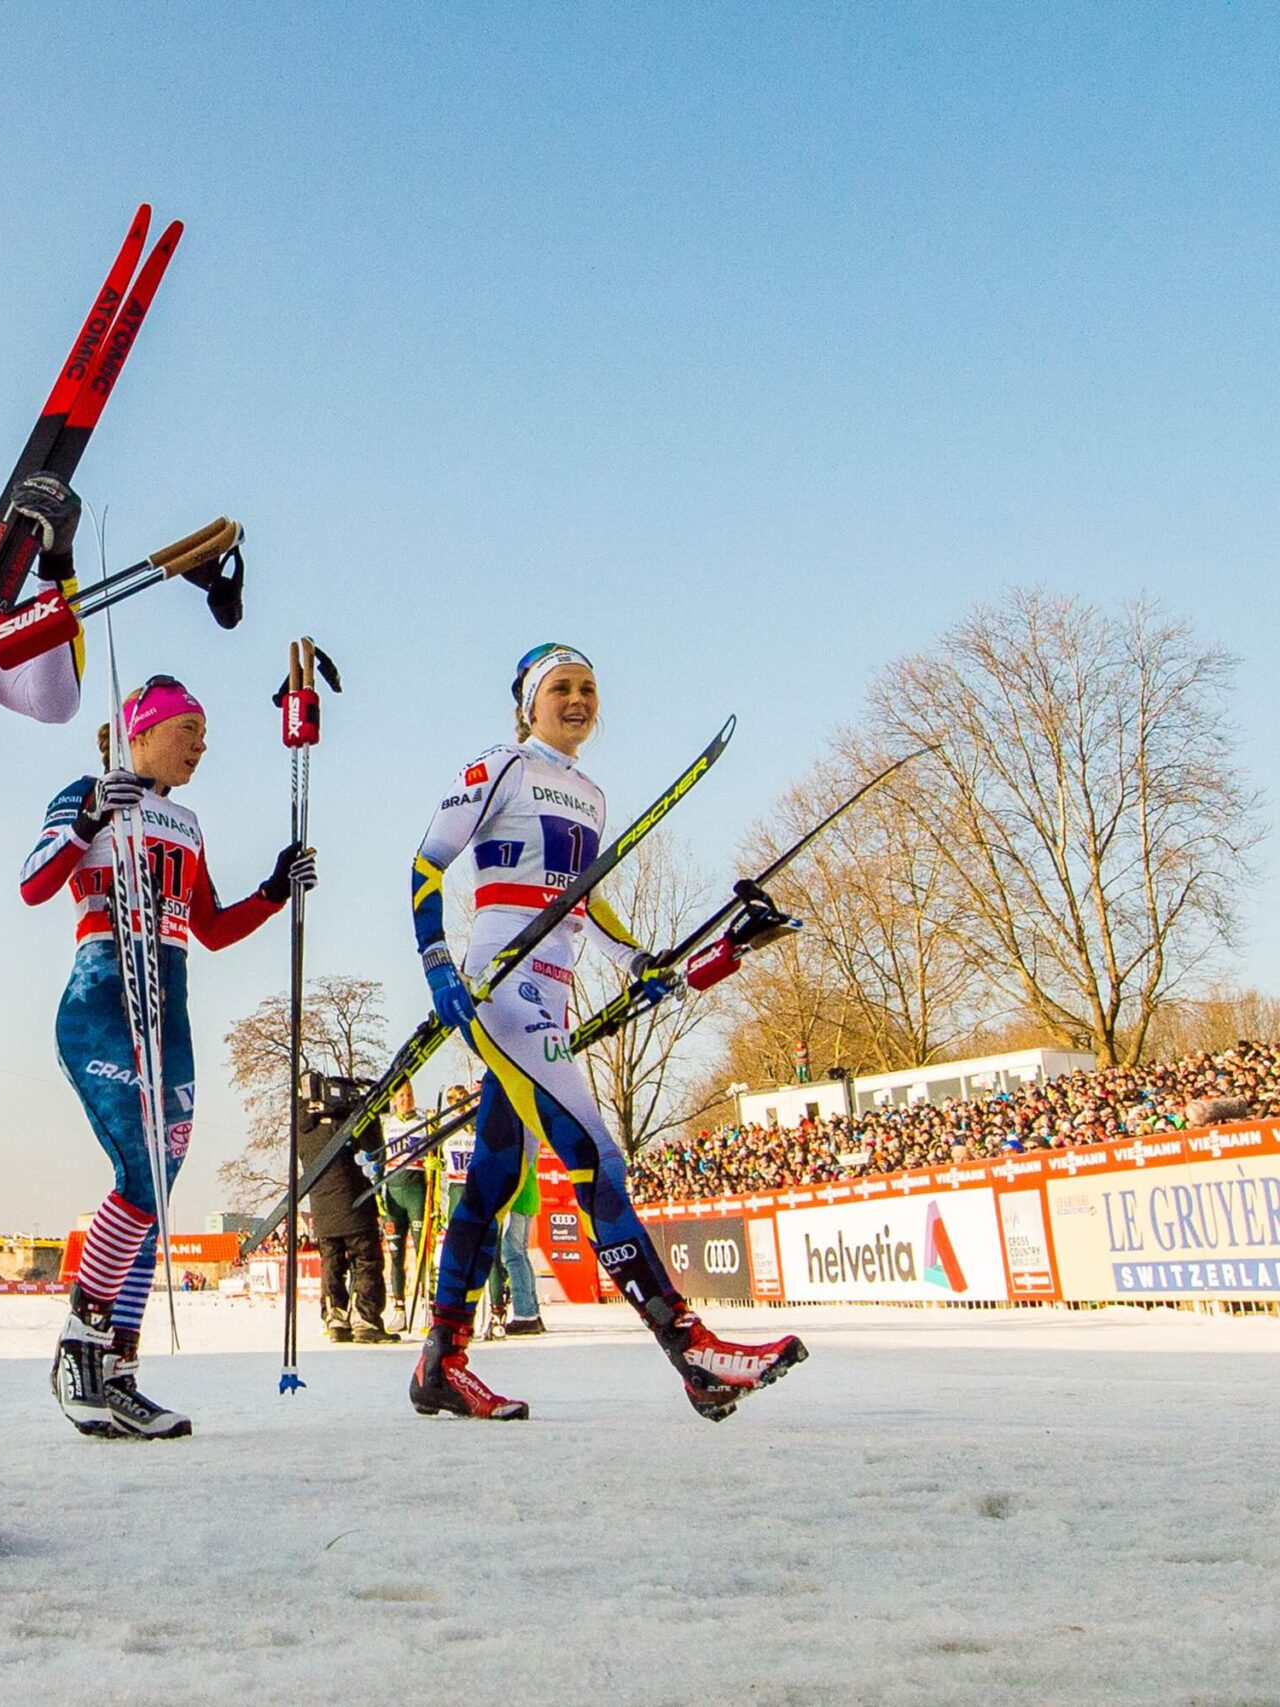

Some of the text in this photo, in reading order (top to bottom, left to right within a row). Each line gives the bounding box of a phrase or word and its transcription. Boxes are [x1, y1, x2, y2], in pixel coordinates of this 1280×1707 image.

[66, 285, 119, 381] ATOMIC
[91, 297, 144, 396] ATOMIC
[532, 785, 591, 816] DREWAG
[617, 756, 708, 857] FISCHER
[122, 808, 191, 837] DEWAG
[499, 842, 512, 866] 1
[568, 823, 582, 875] 1
[148, 840, 185, 900] 11
[118, 859, 144, 1038] MADSHUS
[138, 851, 160, 1030] MADSHUS
[533, 959, 572, 985] BAUH
[86, 1060, 144, 1090] CRA
[1113, 1140, 1181, 1167] VIESSMANN
[1188, 1130, 1262, 1158] VIESSMANN
[1048, 1151, 1107, 1175] VIESSMANN
[1102, 1163, 1280, 1252] LE GRUYÈR
[805, 1224, 918, 1284] helvetia
[1008, 1236, 1030, 1247] CROSS
[1010, 1247, 1041, 1258] COUNTRY
[671, 1243, 689, 1273] Q5
[624, 1279, 644, 1302] 1
[1121, 1262, 1280, 1289] SWITZERLA
[683, 1347, 780, 1377] alpina
[449, 1367, 492, 1401] alpina
